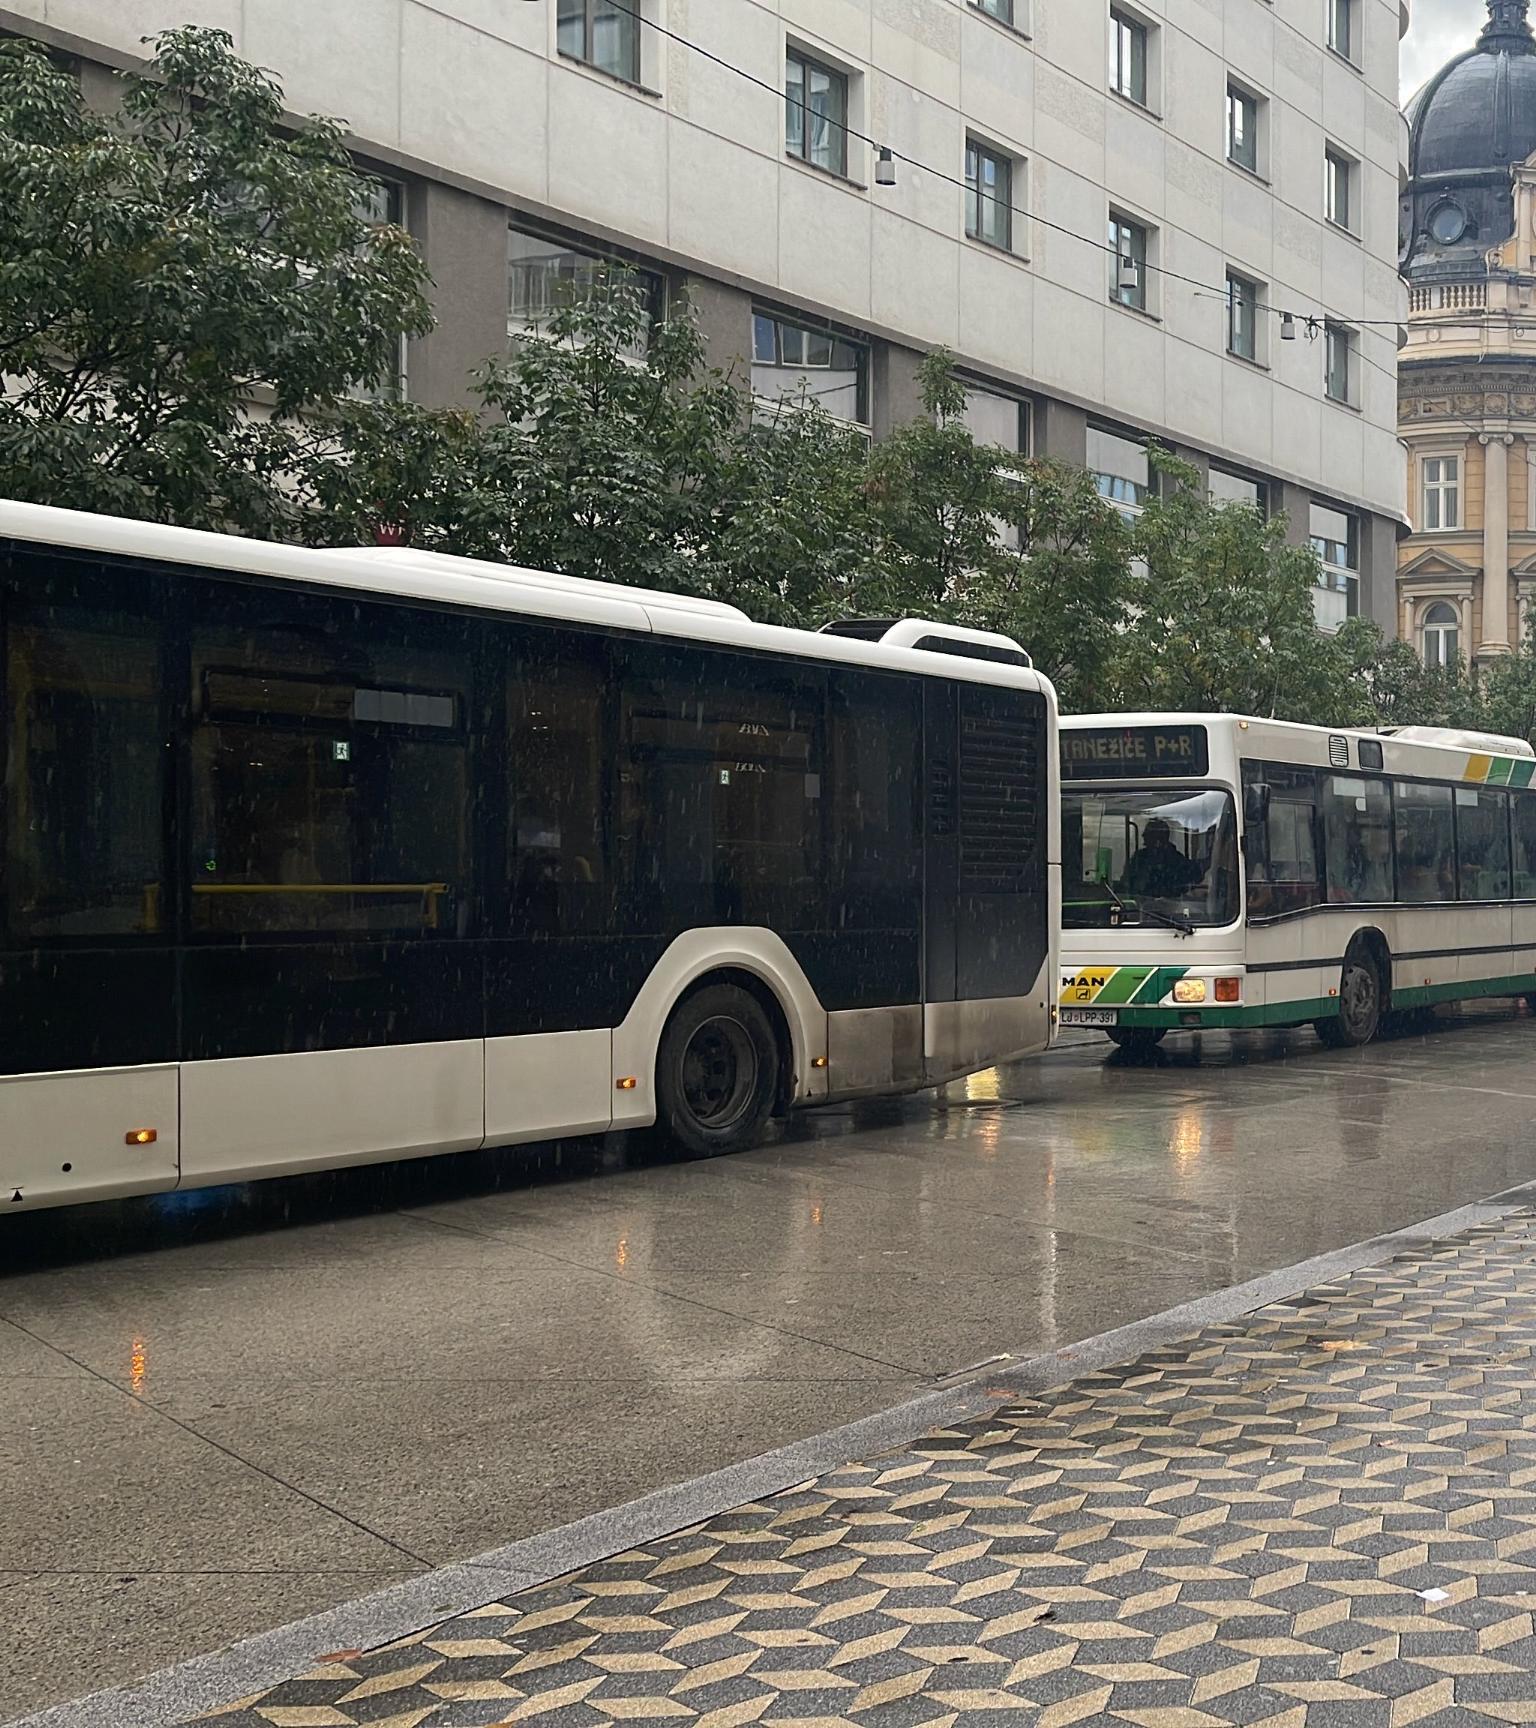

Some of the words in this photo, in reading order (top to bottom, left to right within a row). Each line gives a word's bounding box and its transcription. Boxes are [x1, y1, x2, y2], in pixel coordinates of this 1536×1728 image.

[1154, 735, 1192, 758] P+R
[1062, 977, 1104, 986] MAN
[1061, 1012, 1072, 1022] LJ
[1080, 1012, 1114, 1023] LPP-391
